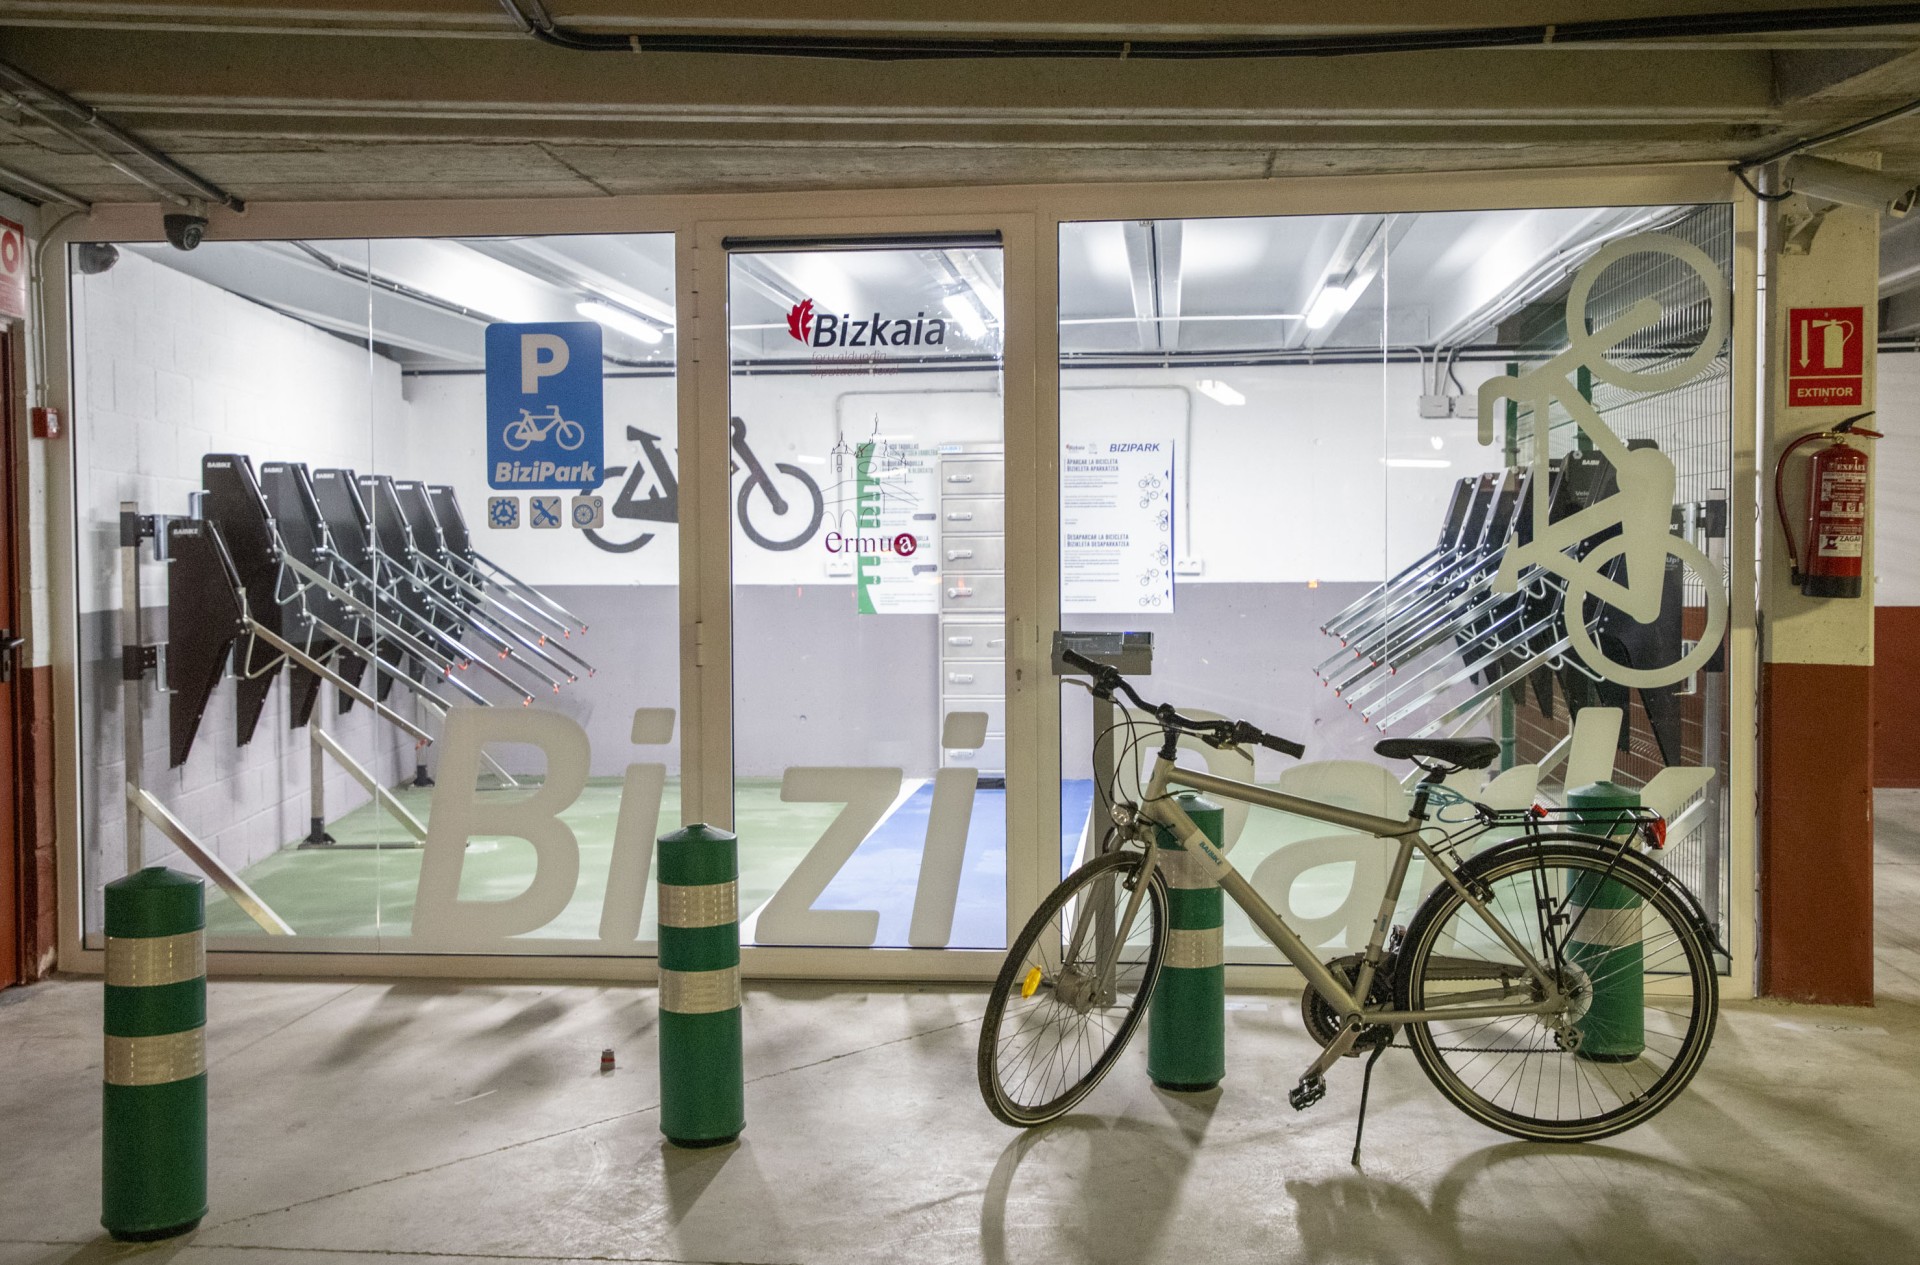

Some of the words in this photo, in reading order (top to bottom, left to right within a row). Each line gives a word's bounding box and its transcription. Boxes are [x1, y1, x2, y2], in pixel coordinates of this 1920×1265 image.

[813, 312, 946, 347] Bizkaia
[521, 333, 570, 394] P
[1797, 387, 1853, 397] EXTINTOR
[1109, 443, 1160, 452] BIZIPARK
[494, 460, 595, 483] BiziPark
[825, 531, 917, 556] ermua
